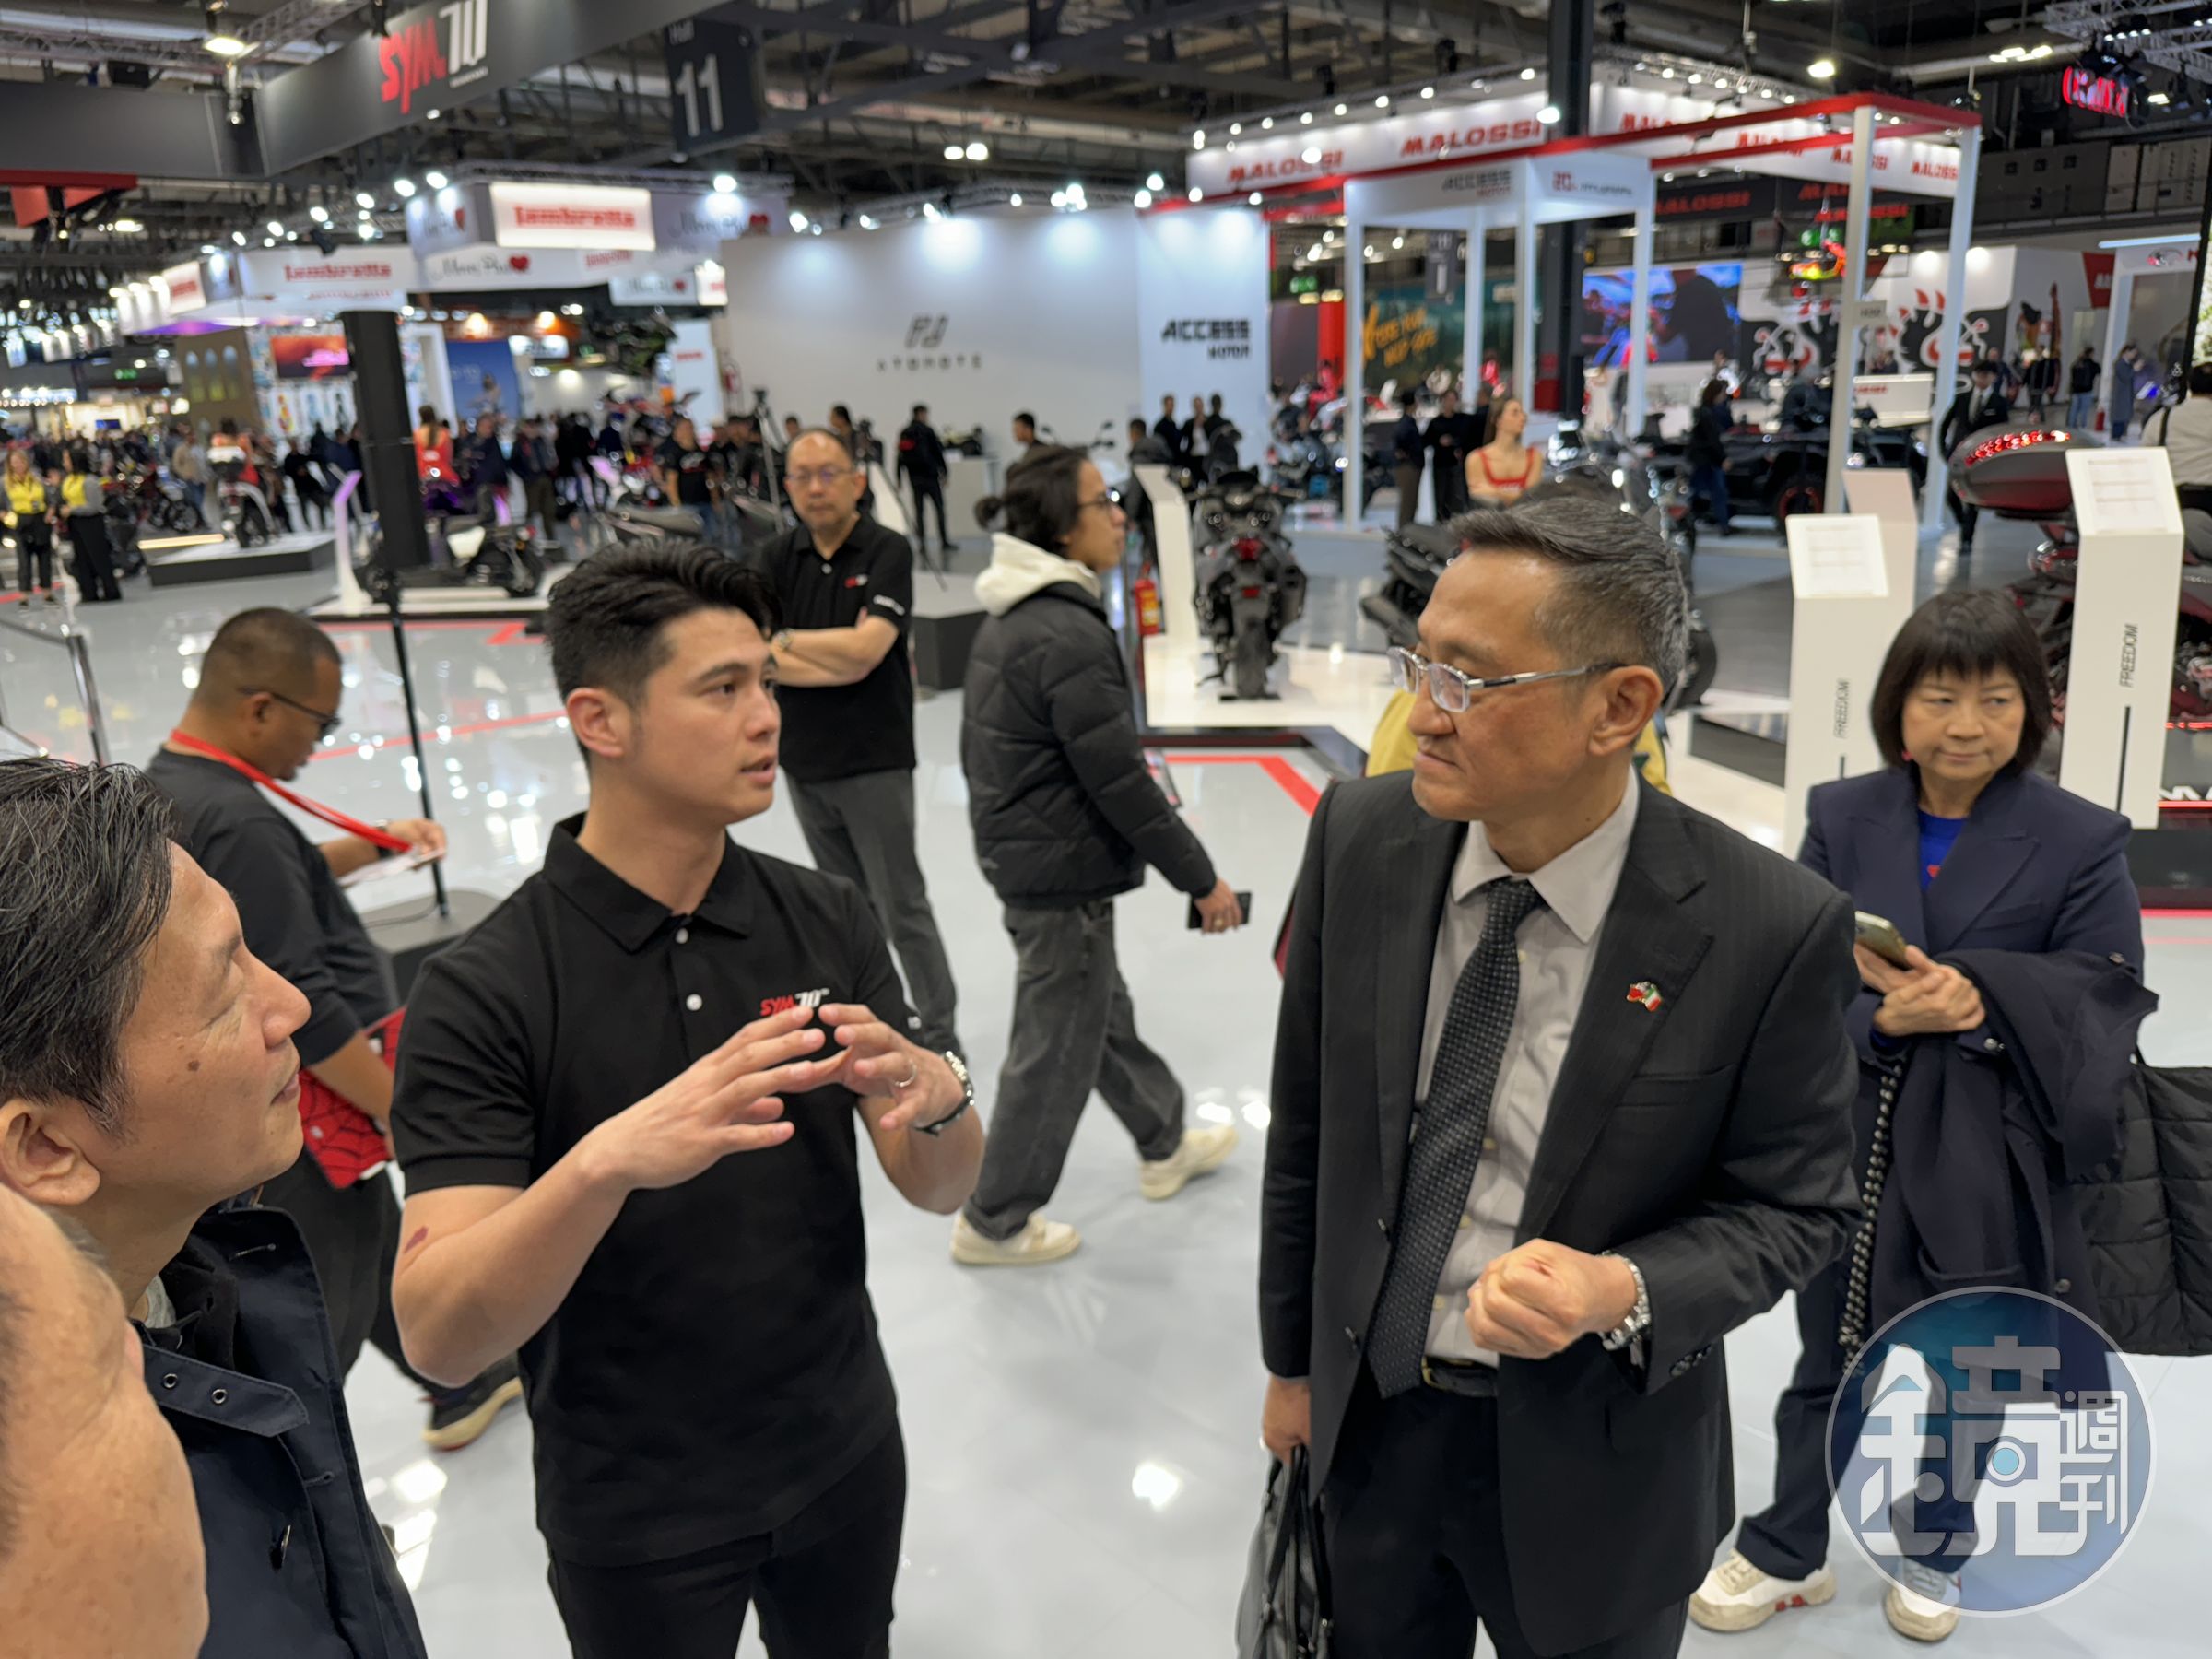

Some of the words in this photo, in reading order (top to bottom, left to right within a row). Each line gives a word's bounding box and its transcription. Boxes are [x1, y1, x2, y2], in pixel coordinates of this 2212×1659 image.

[675, 53, 724, 137] 11
[1401, 119, 1541, 157] MALOSSI
[2119, 623, 2138, 688] FREEDOM
